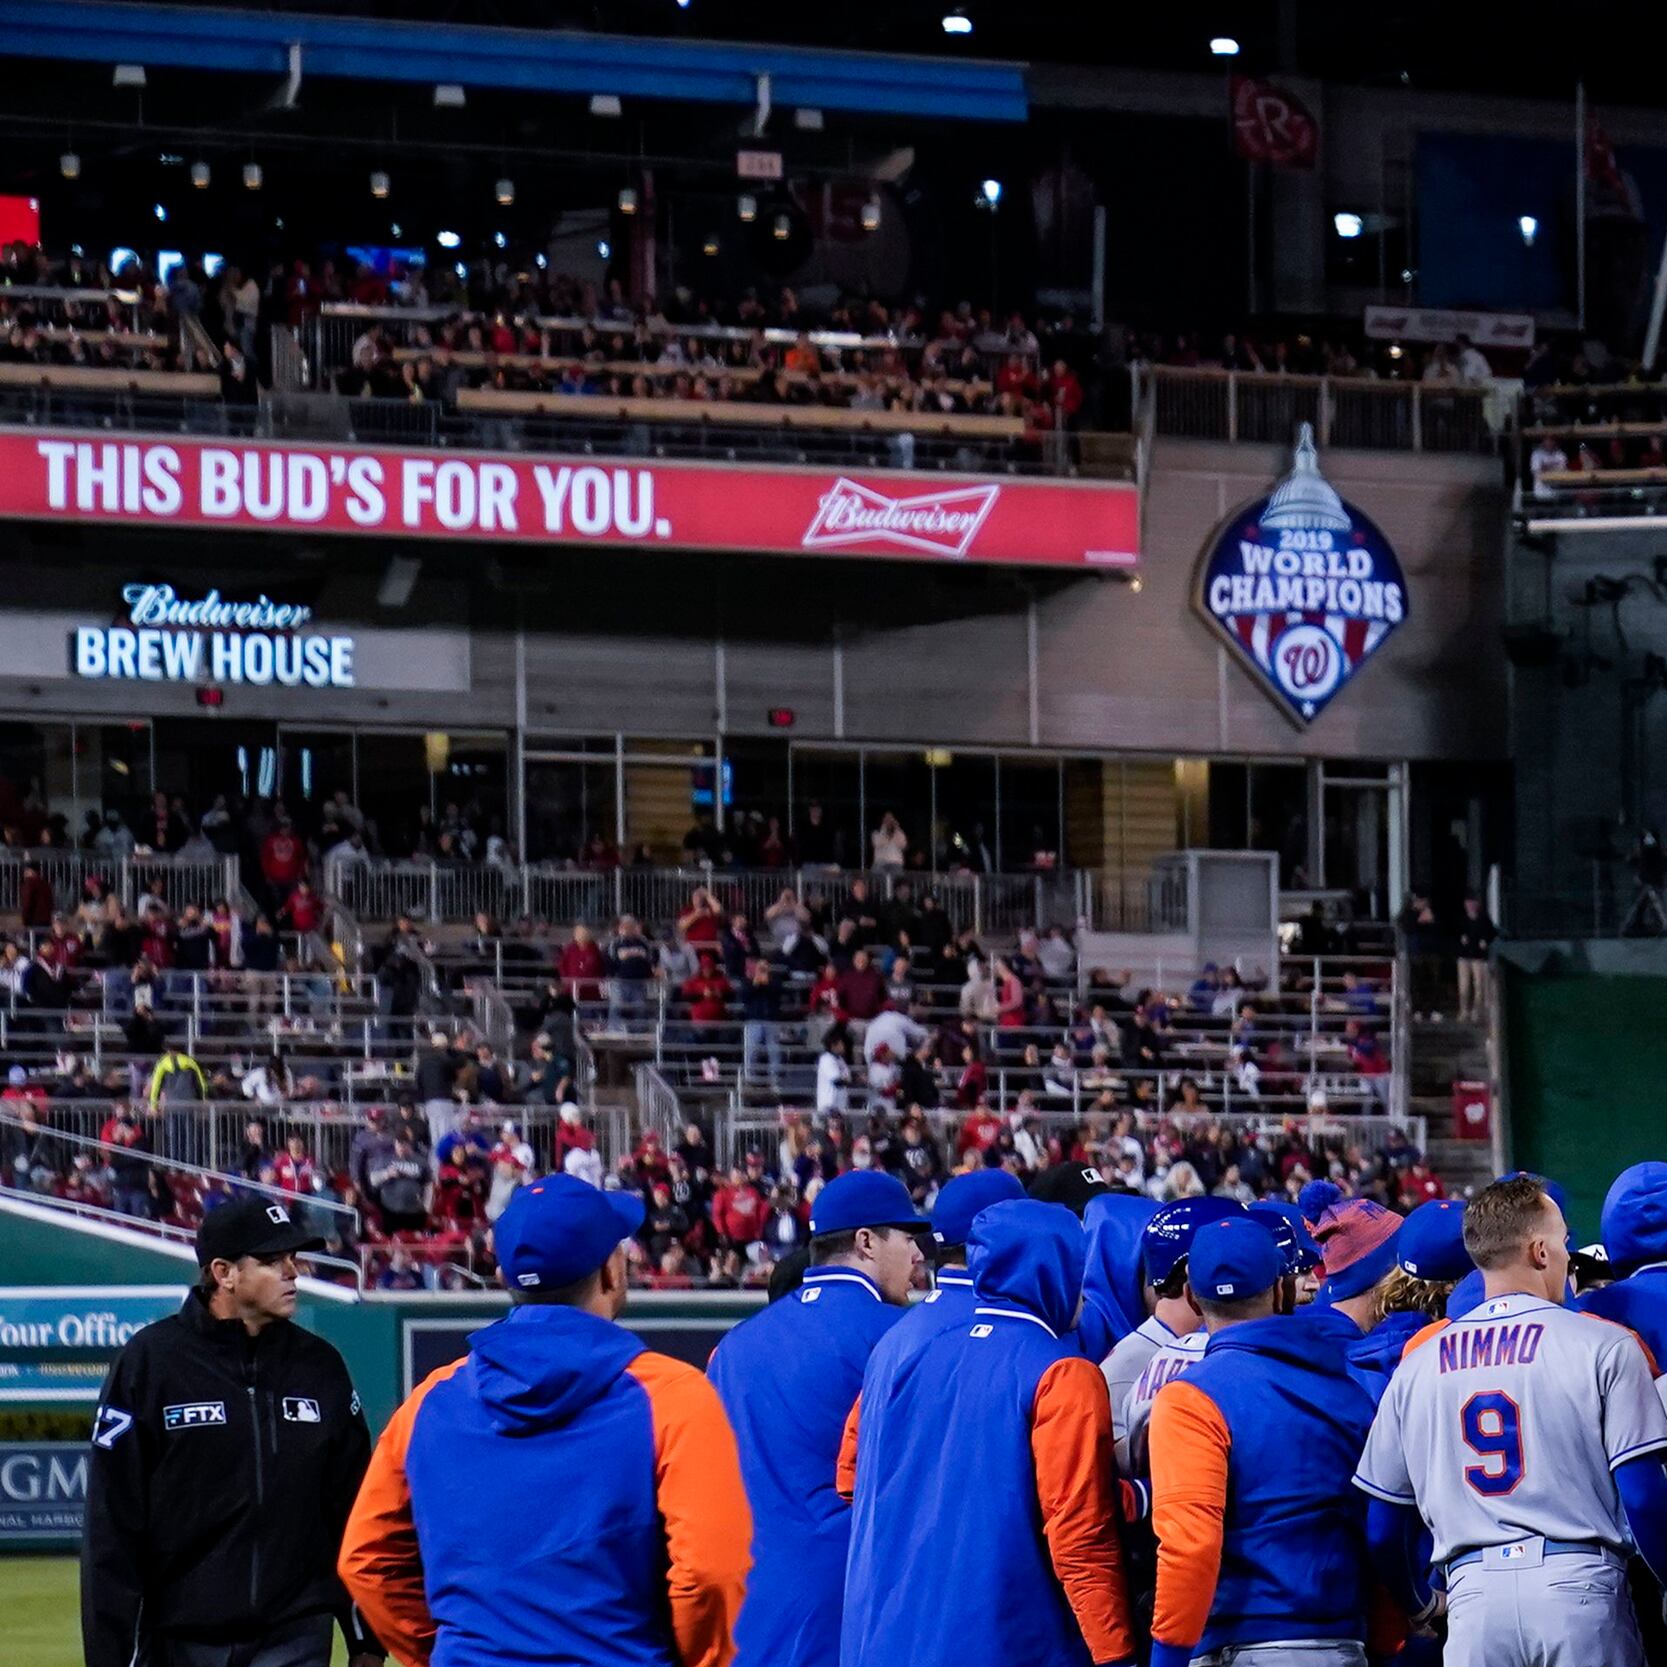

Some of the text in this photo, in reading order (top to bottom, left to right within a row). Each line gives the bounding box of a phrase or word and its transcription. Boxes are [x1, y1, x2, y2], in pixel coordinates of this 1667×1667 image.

[37, 441, 672, 539] THIS BUD'S FOR YOU.
[819, 492, 976, 534] Budweiser
[1239, 541, 1373, 580] WORLD
[1279, 530, 1334, 552] 2019
[123, 583, 311, 630] Budweiser
[1209, 573, 1403, 622] CHAMPIONS
[76, 627, 354, 688] BREW HOUSE
[1439, 1322, 1545, 1375] NIMMO
[185, 1404, 223, 1422] FTX
[1460, 1389, 1526, 1498] 9
